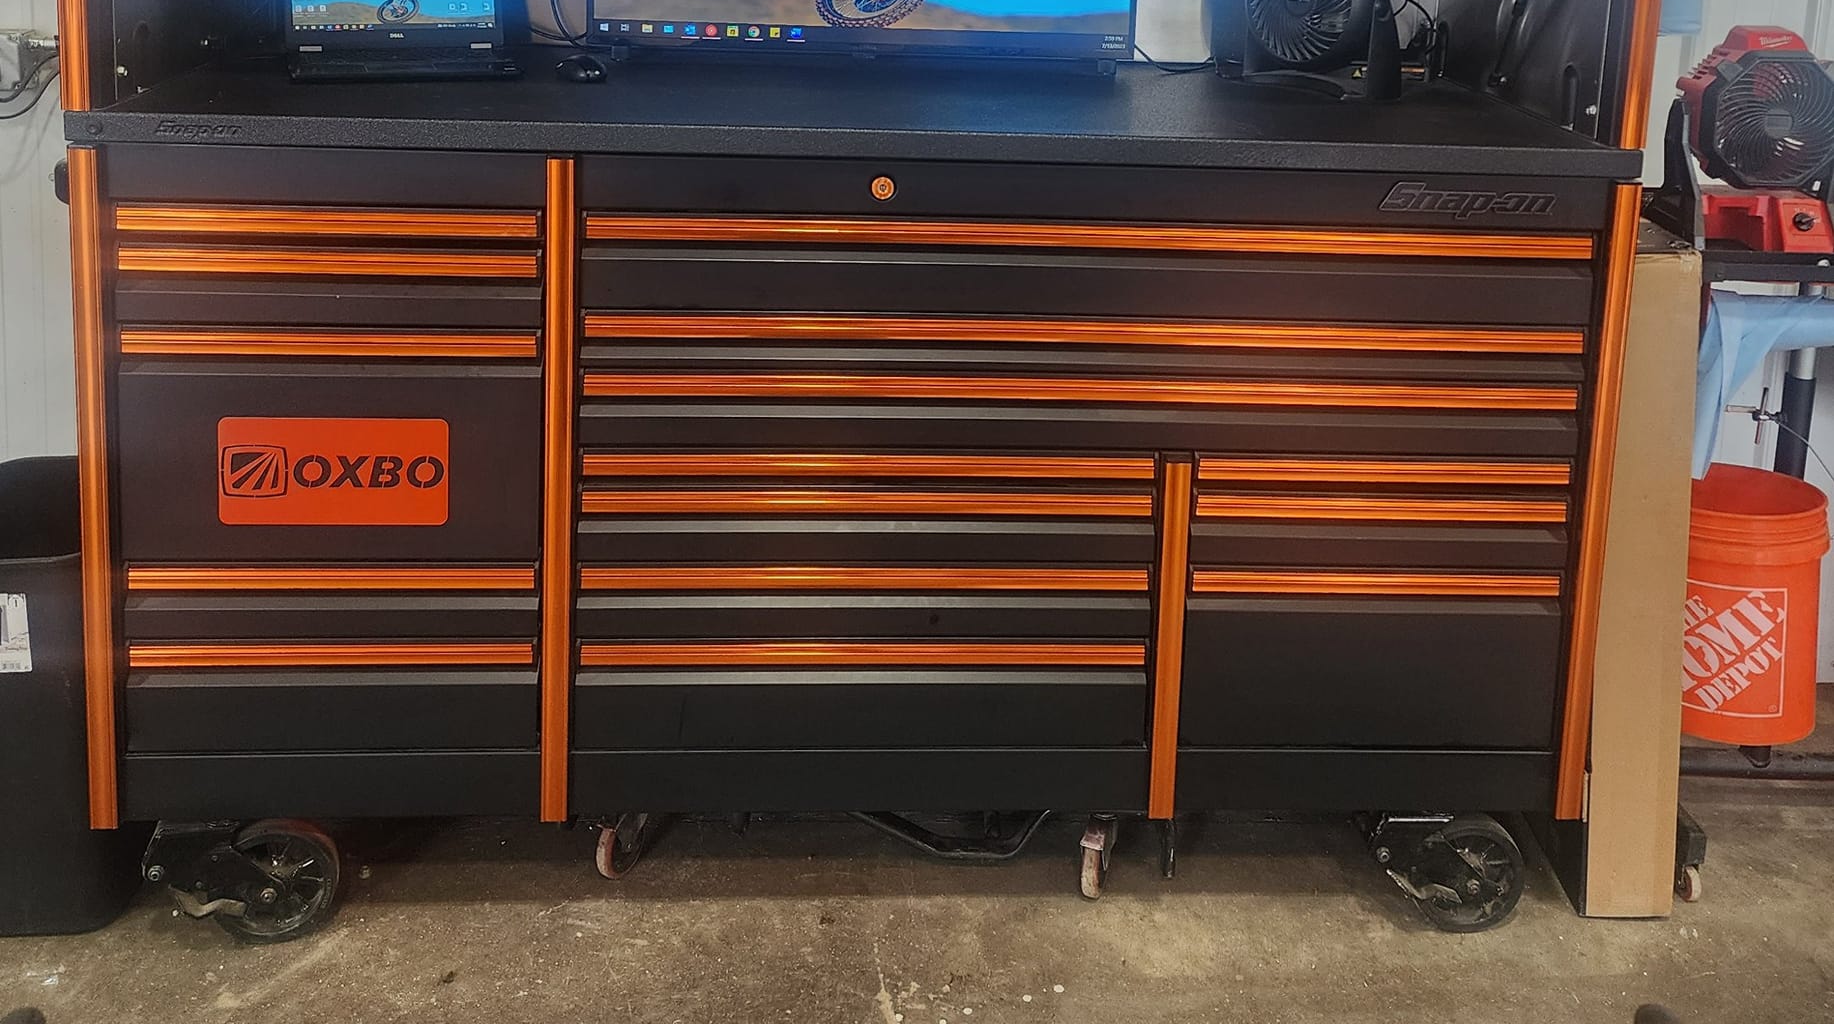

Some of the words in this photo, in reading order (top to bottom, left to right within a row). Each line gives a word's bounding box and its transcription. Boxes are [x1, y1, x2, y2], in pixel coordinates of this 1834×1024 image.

[1378, 182, 1557, 219] Snap-on
[293, 454, 445, 489] OXBO
[1683, 595, 1714, 629] HE
[1695, 636, 1783, 712] DEPOT
